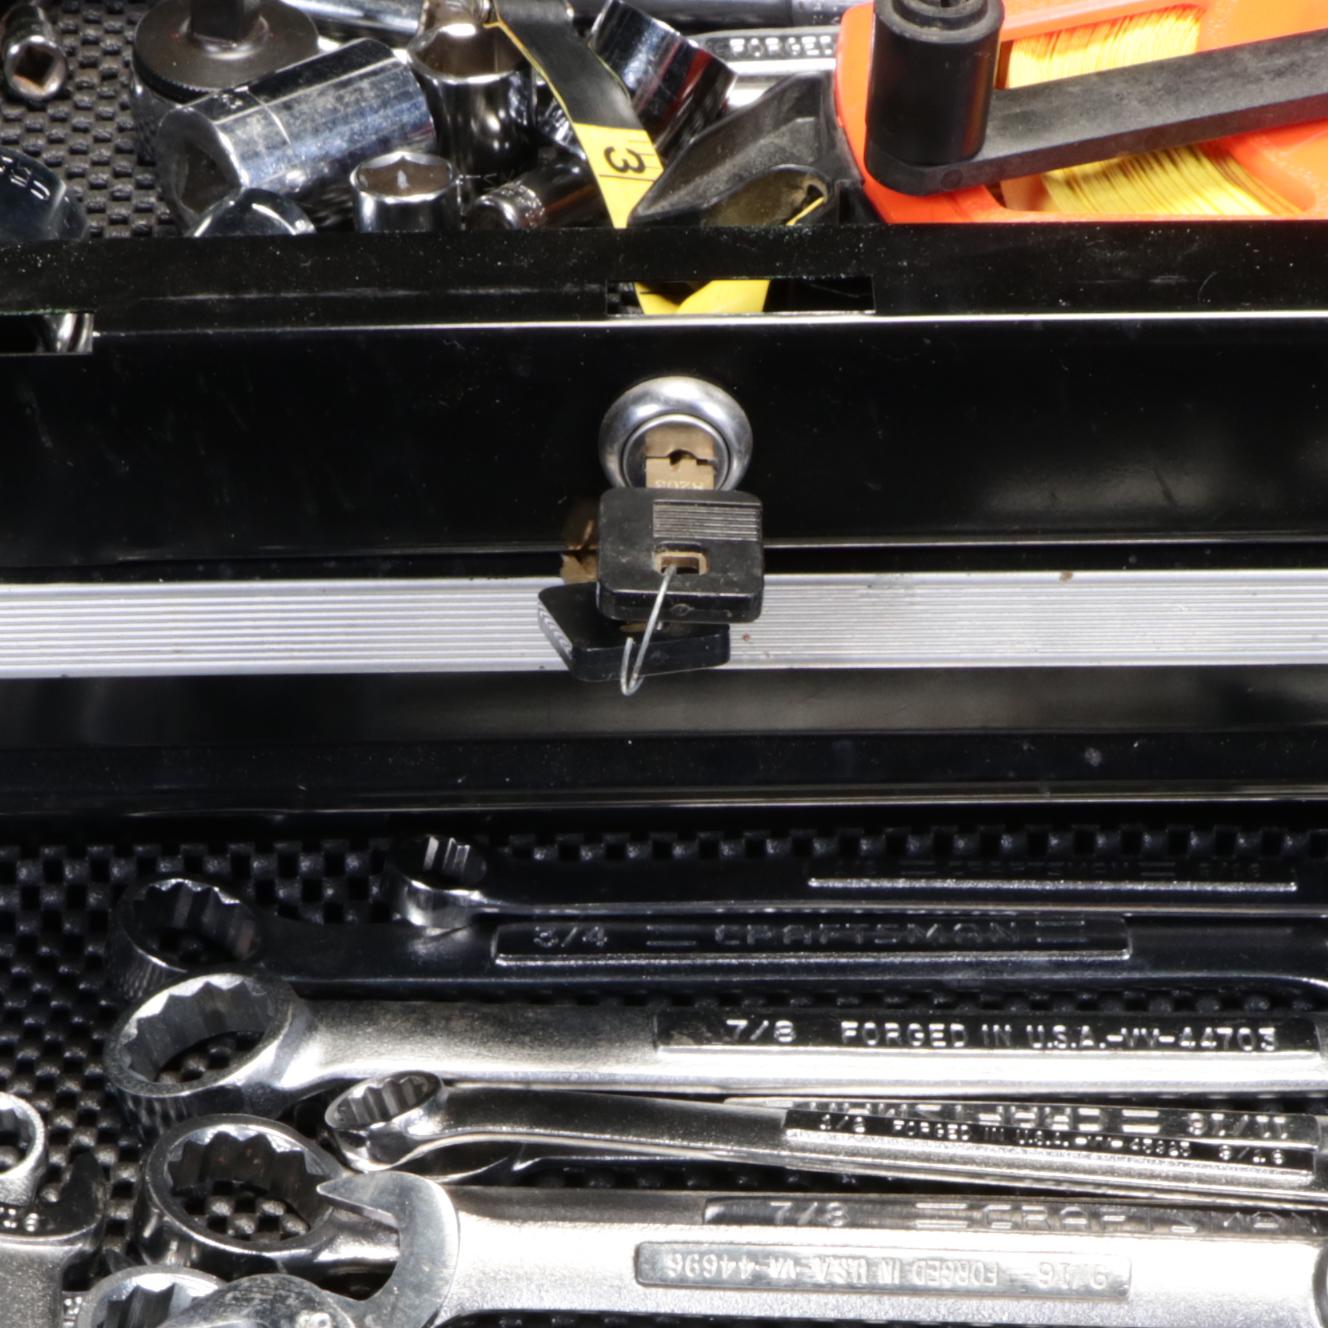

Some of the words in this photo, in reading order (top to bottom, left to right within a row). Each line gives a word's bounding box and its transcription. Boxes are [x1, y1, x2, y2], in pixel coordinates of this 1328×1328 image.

[603, 145, 647, 175] 3
[714, 923, 1021, 946] CRAFTSMAN
[726, 1019, 796, 1043] 7/8
[840, 1020, 969, 1049] FORGED
[980, 1023, 1012, 1048] IN
[875, 1256, 903, 1286] IN
[910, 1256, 1001, 1288] FORGED
